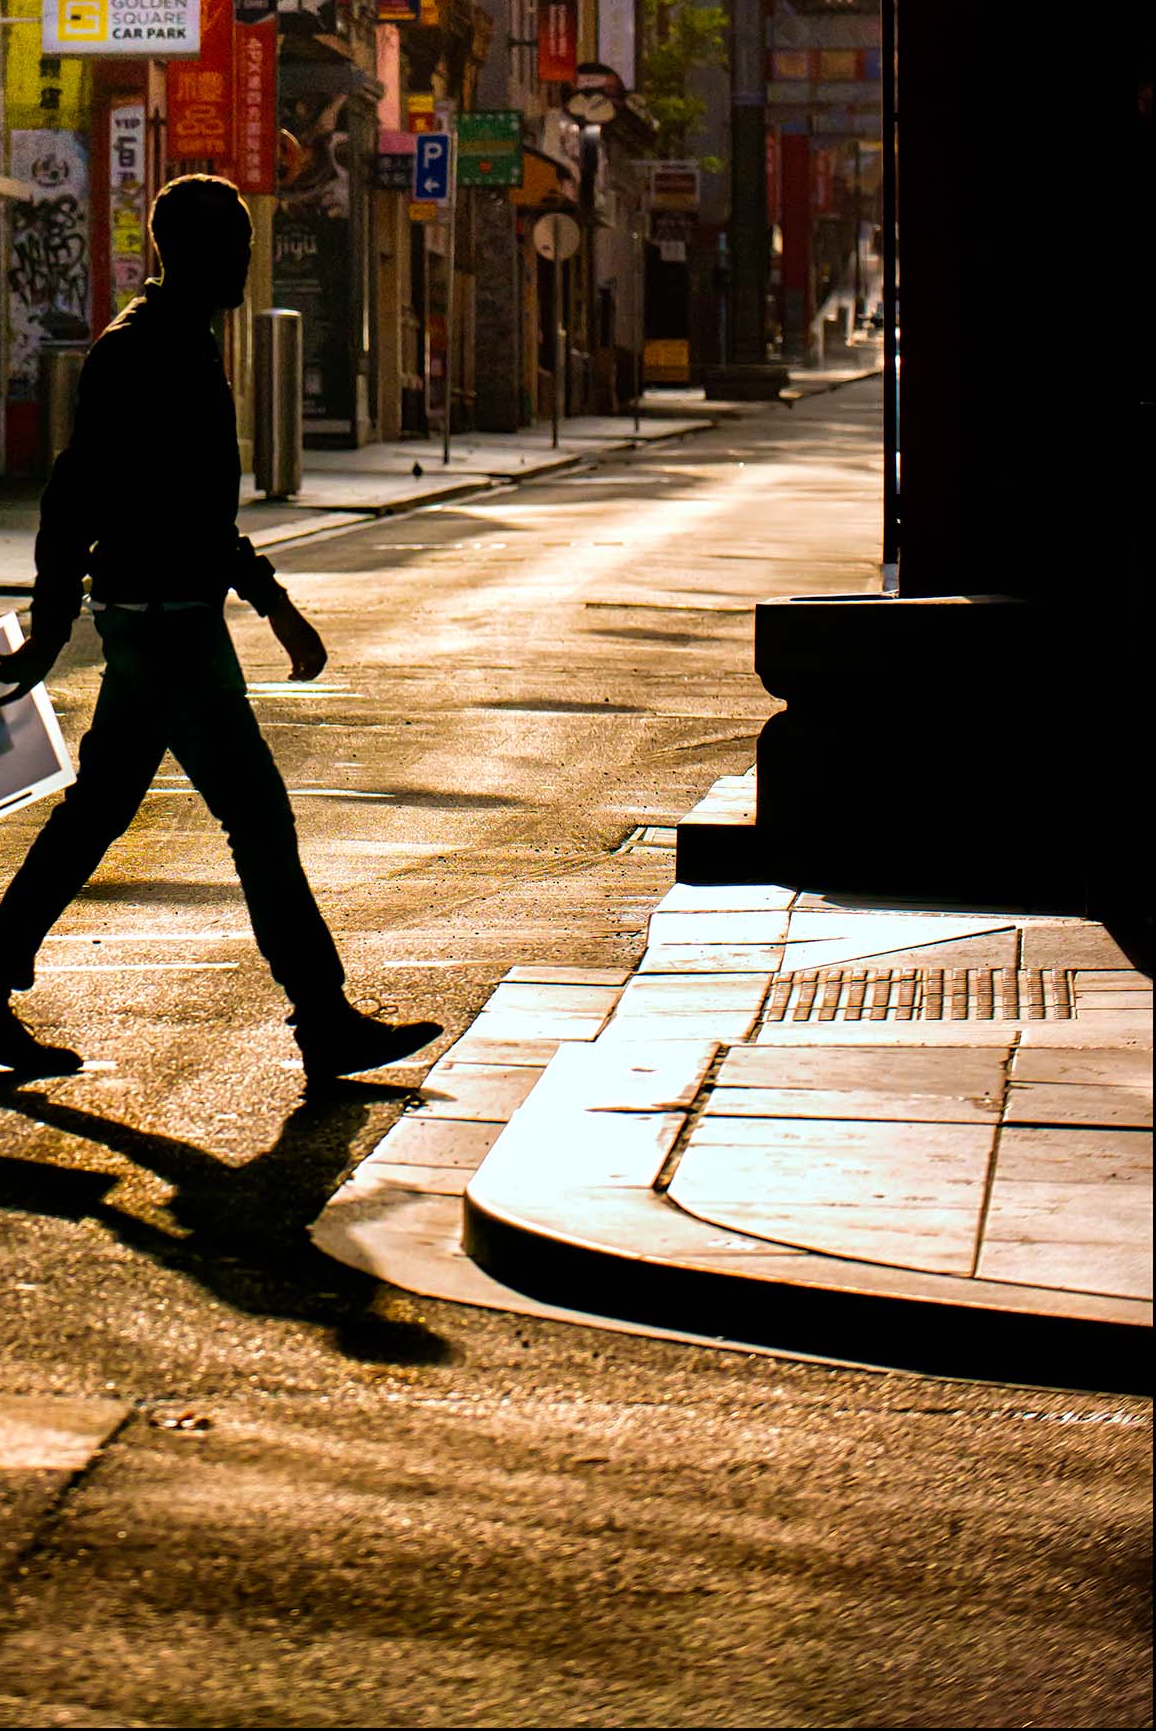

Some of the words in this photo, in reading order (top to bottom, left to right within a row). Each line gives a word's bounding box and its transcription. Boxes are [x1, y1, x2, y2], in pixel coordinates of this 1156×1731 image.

[111, 11, 187, 26] SQUARE
[112, 28, 143, 39] CAR
[147, 28, 187, 39] PARK
[423, 141, 444, 170] P
